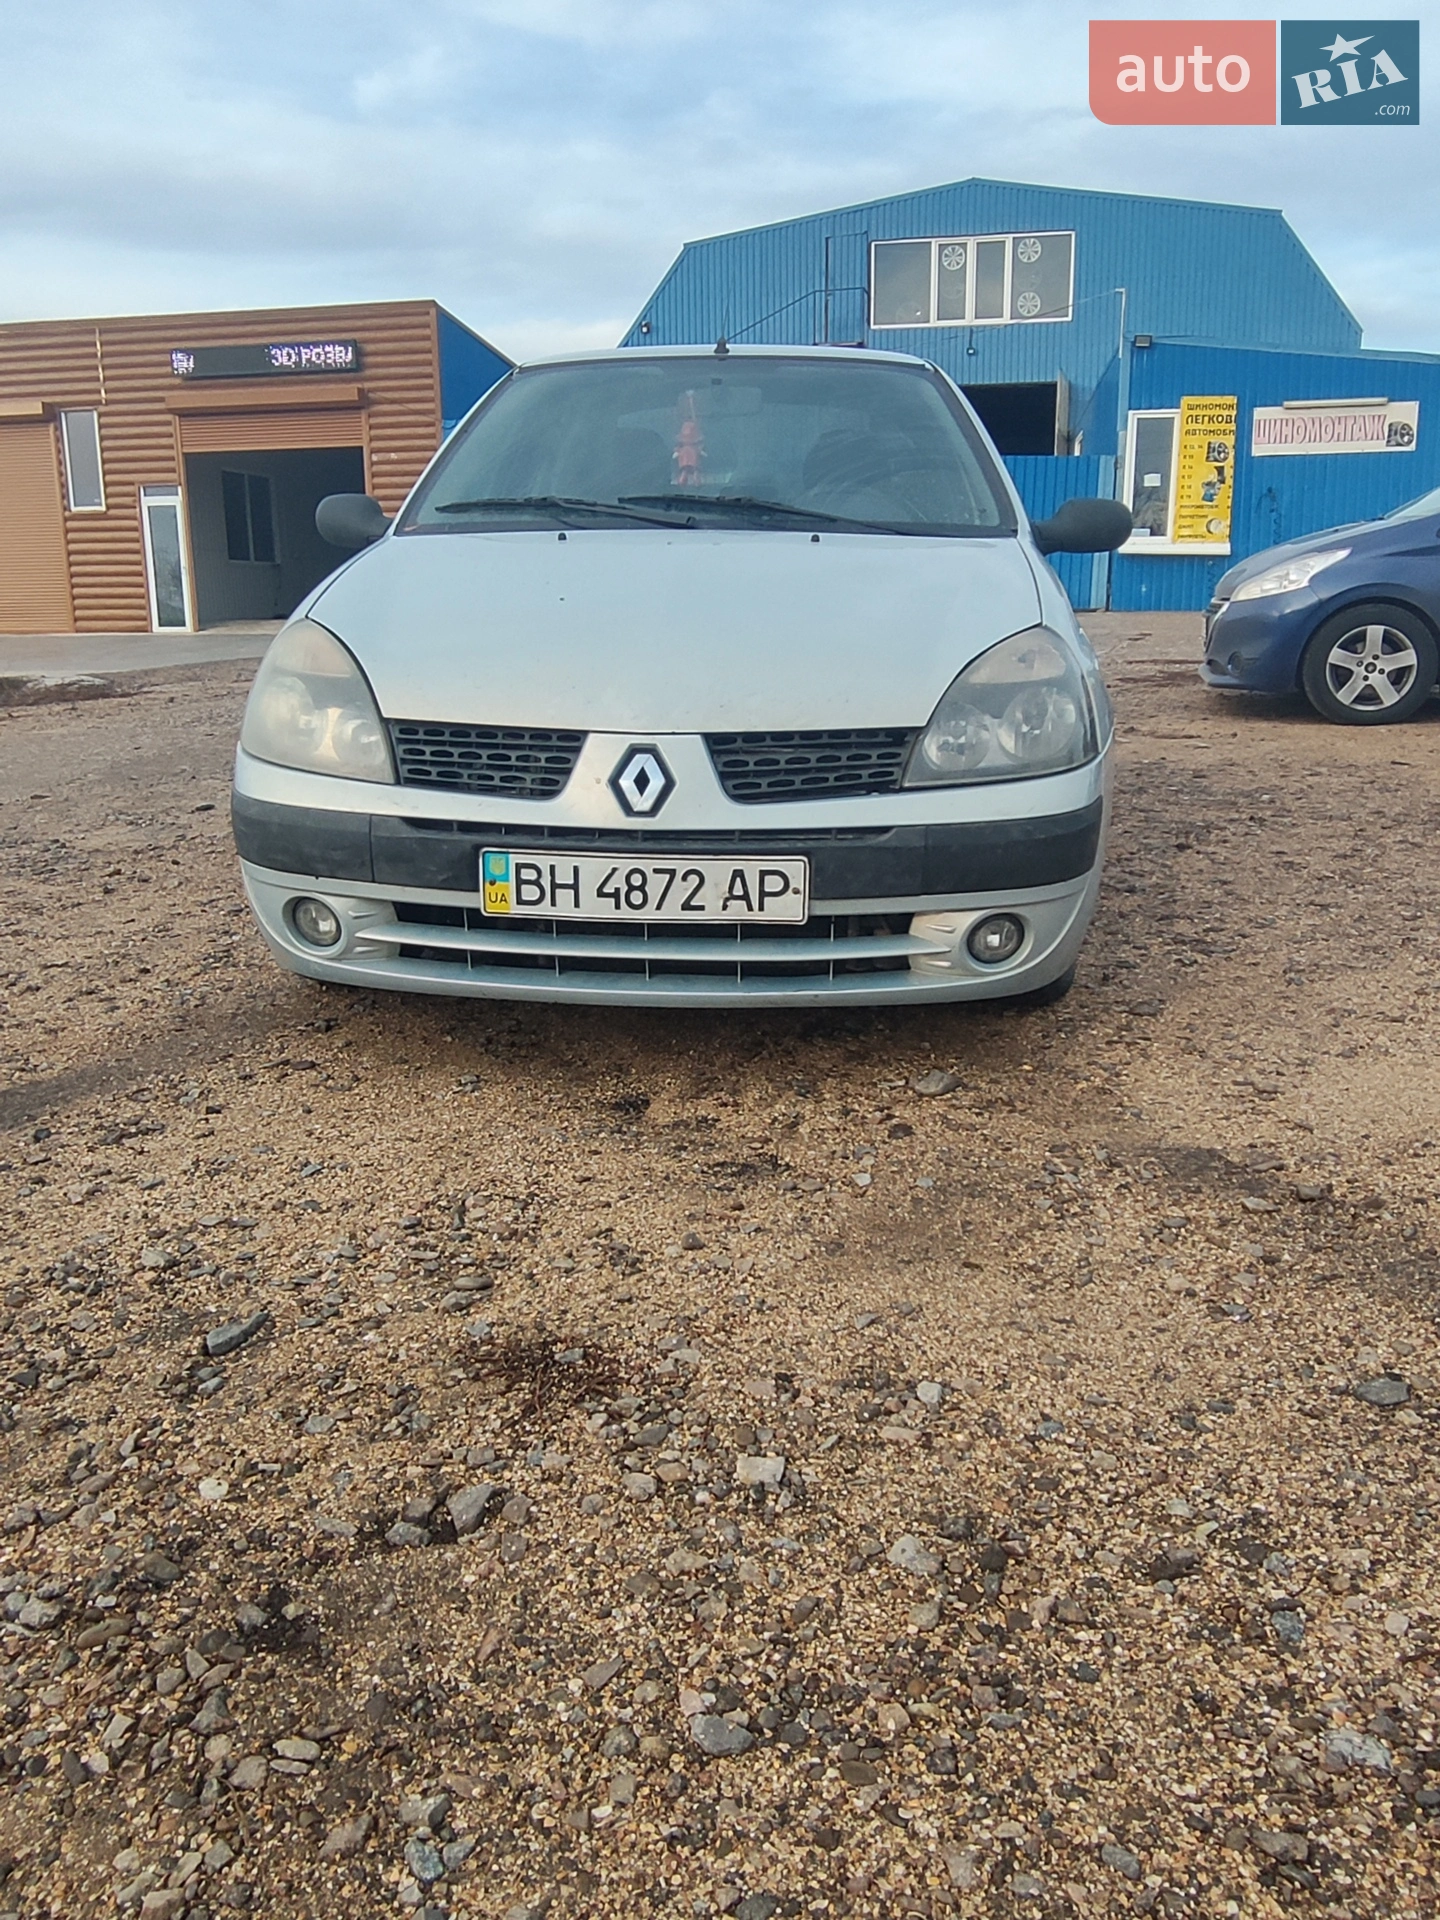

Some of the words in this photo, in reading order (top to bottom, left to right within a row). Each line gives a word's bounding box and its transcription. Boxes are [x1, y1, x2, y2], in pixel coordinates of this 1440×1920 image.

[1254, 414, 1388, 445] ШИНОМОНТАЖ
[488, 892, 508, 905] UA
[514, 862, 580, 909] BH
[596, 866, 706, 912] 4872
[721, 868, 790, 912] AP
